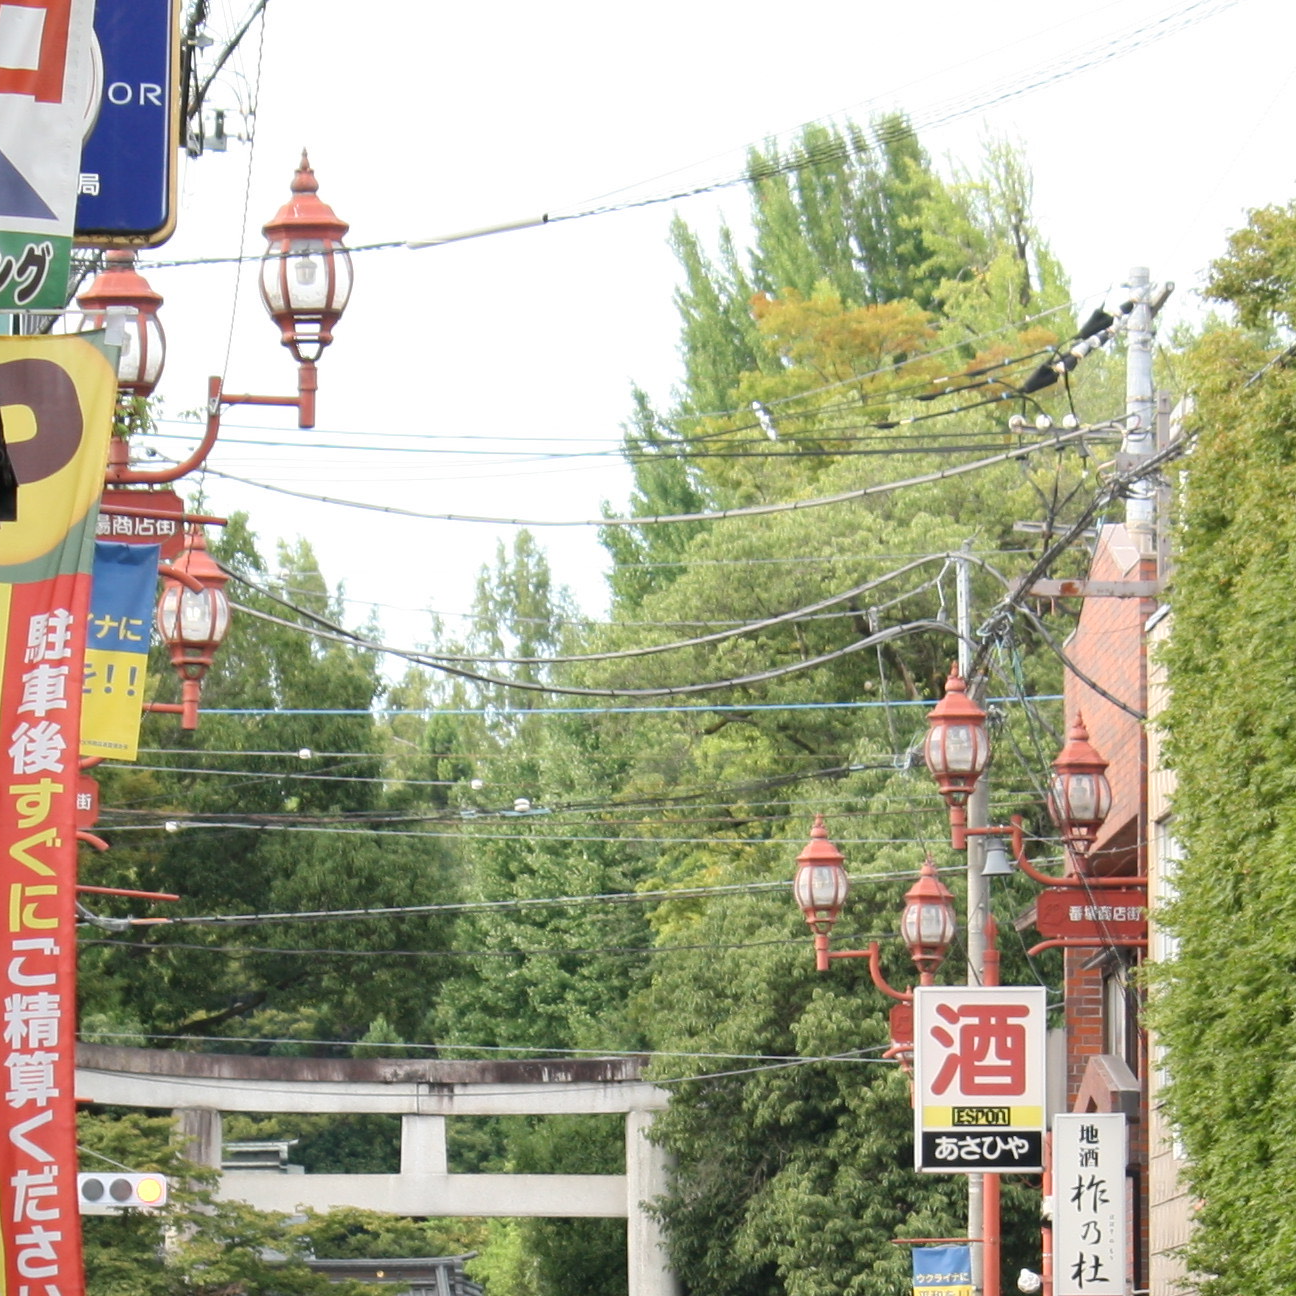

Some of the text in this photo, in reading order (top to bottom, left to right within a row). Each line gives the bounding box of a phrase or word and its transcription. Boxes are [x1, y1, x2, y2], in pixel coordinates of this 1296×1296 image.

[930, 1003, 1030, 1097] 酒
[934, 1136, 1030, 1161] あさひや
[1079, 1124, 1100, 1168] 地酒
[917, 1272, 969, 1283] ウクライナに
